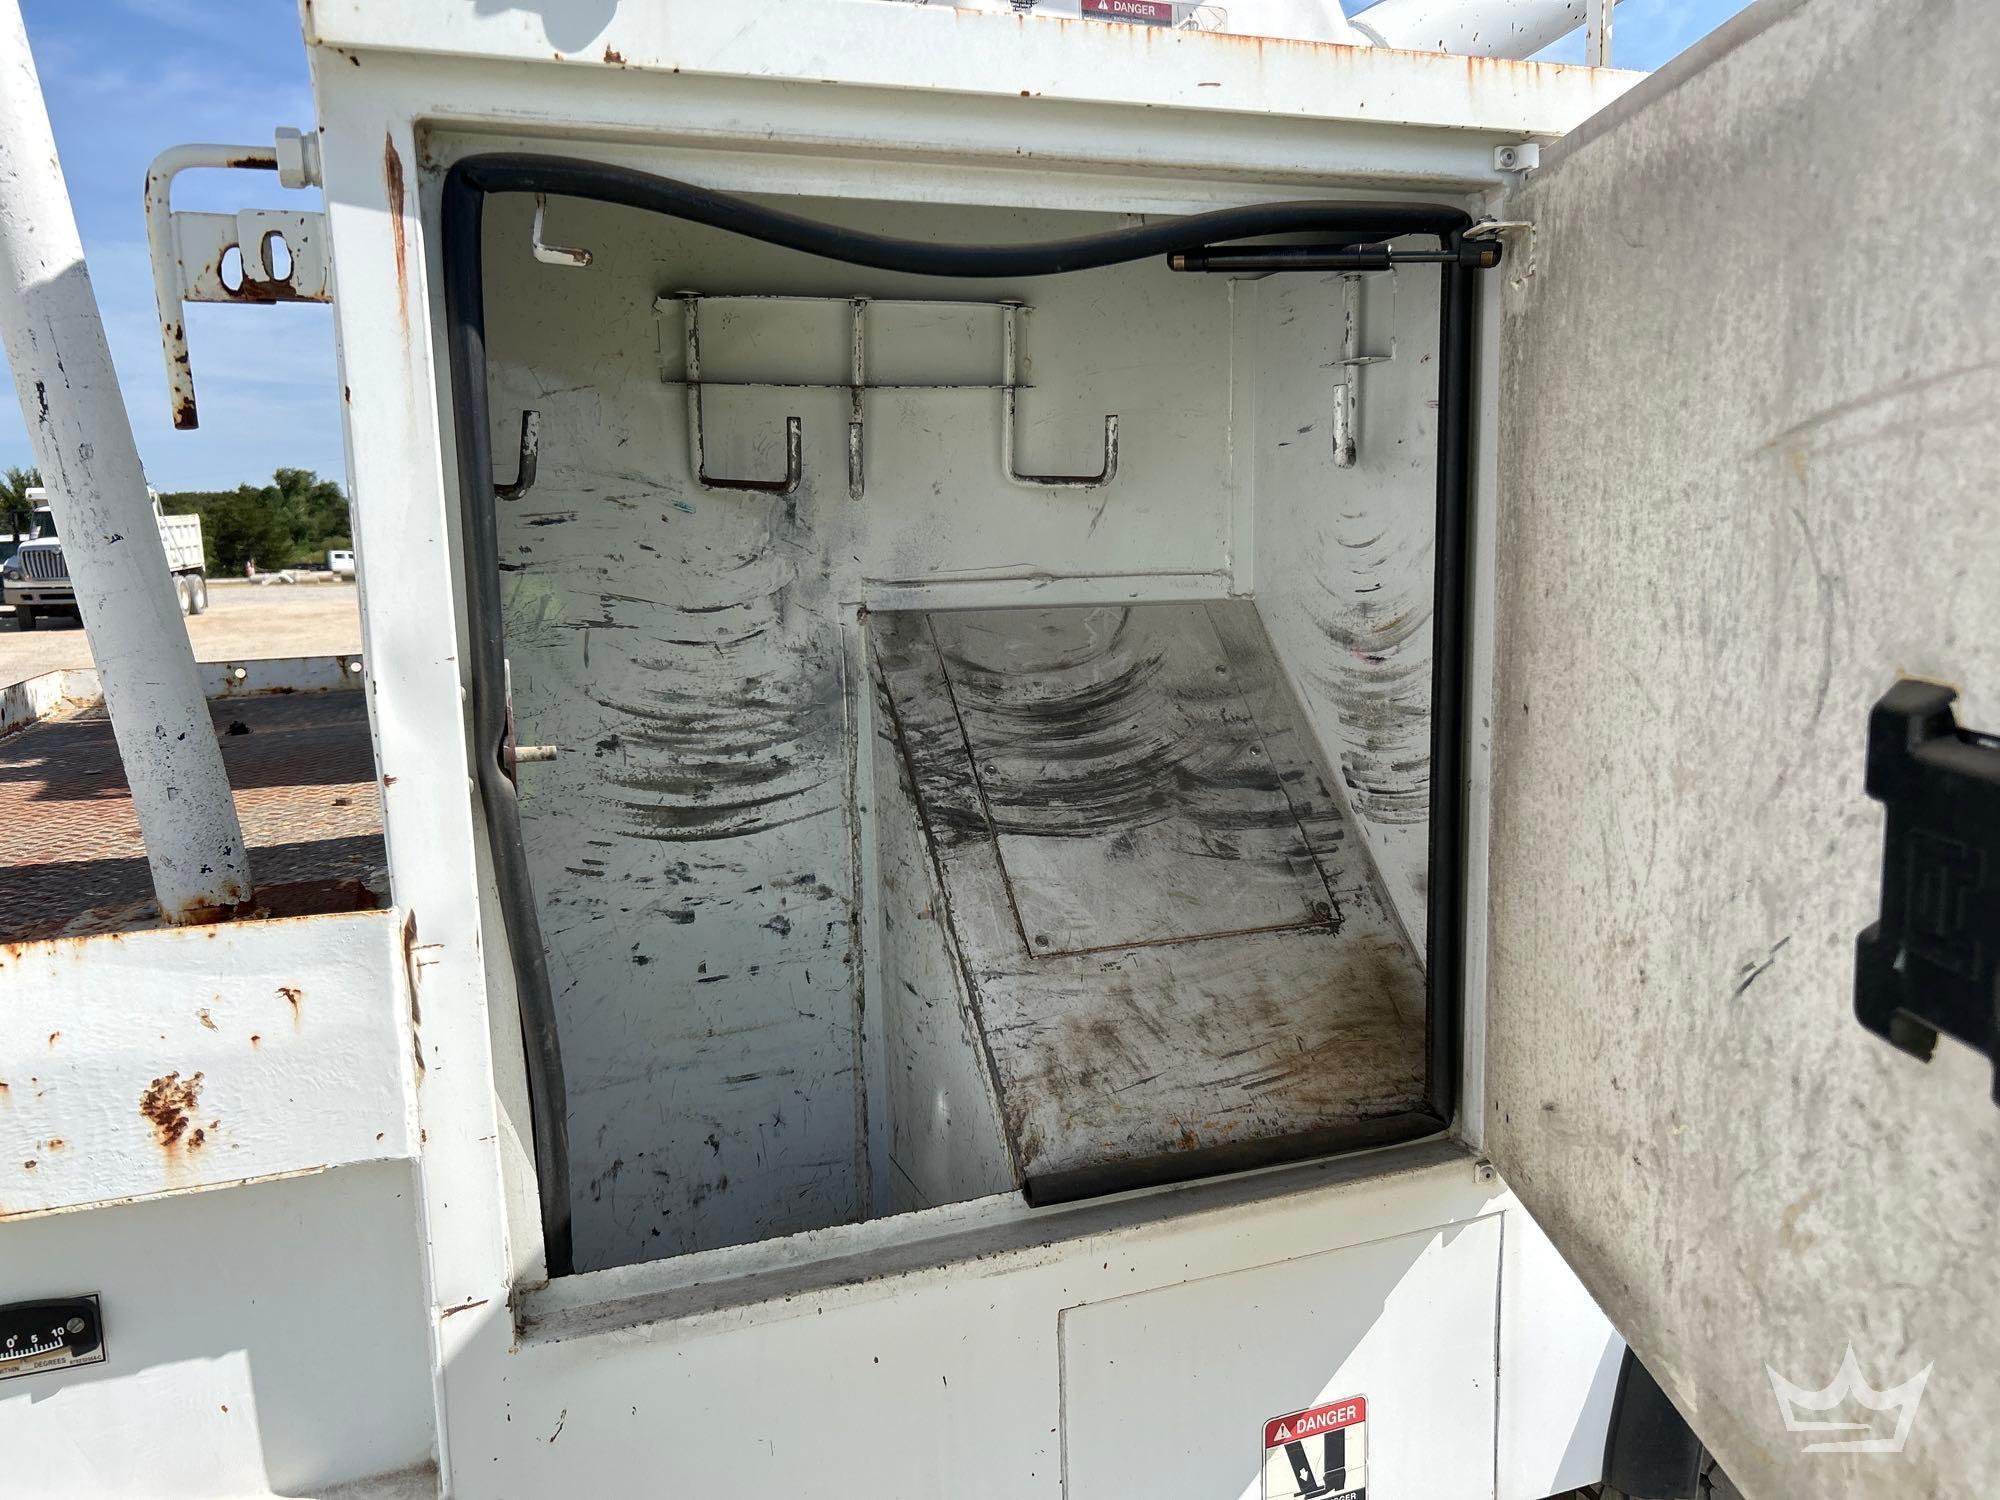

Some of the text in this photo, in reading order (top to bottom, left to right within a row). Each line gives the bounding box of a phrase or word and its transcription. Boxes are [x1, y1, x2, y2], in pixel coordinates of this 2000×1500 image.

[1113, 1, 1156, 16] DANGER
[30, 1334, 39, 1343] 5
[51, 1326, 65, 1338] 10
[34, 1359, 67, 1369] DEGREES
[1296, 1404, 1357, 1434] DANGER
